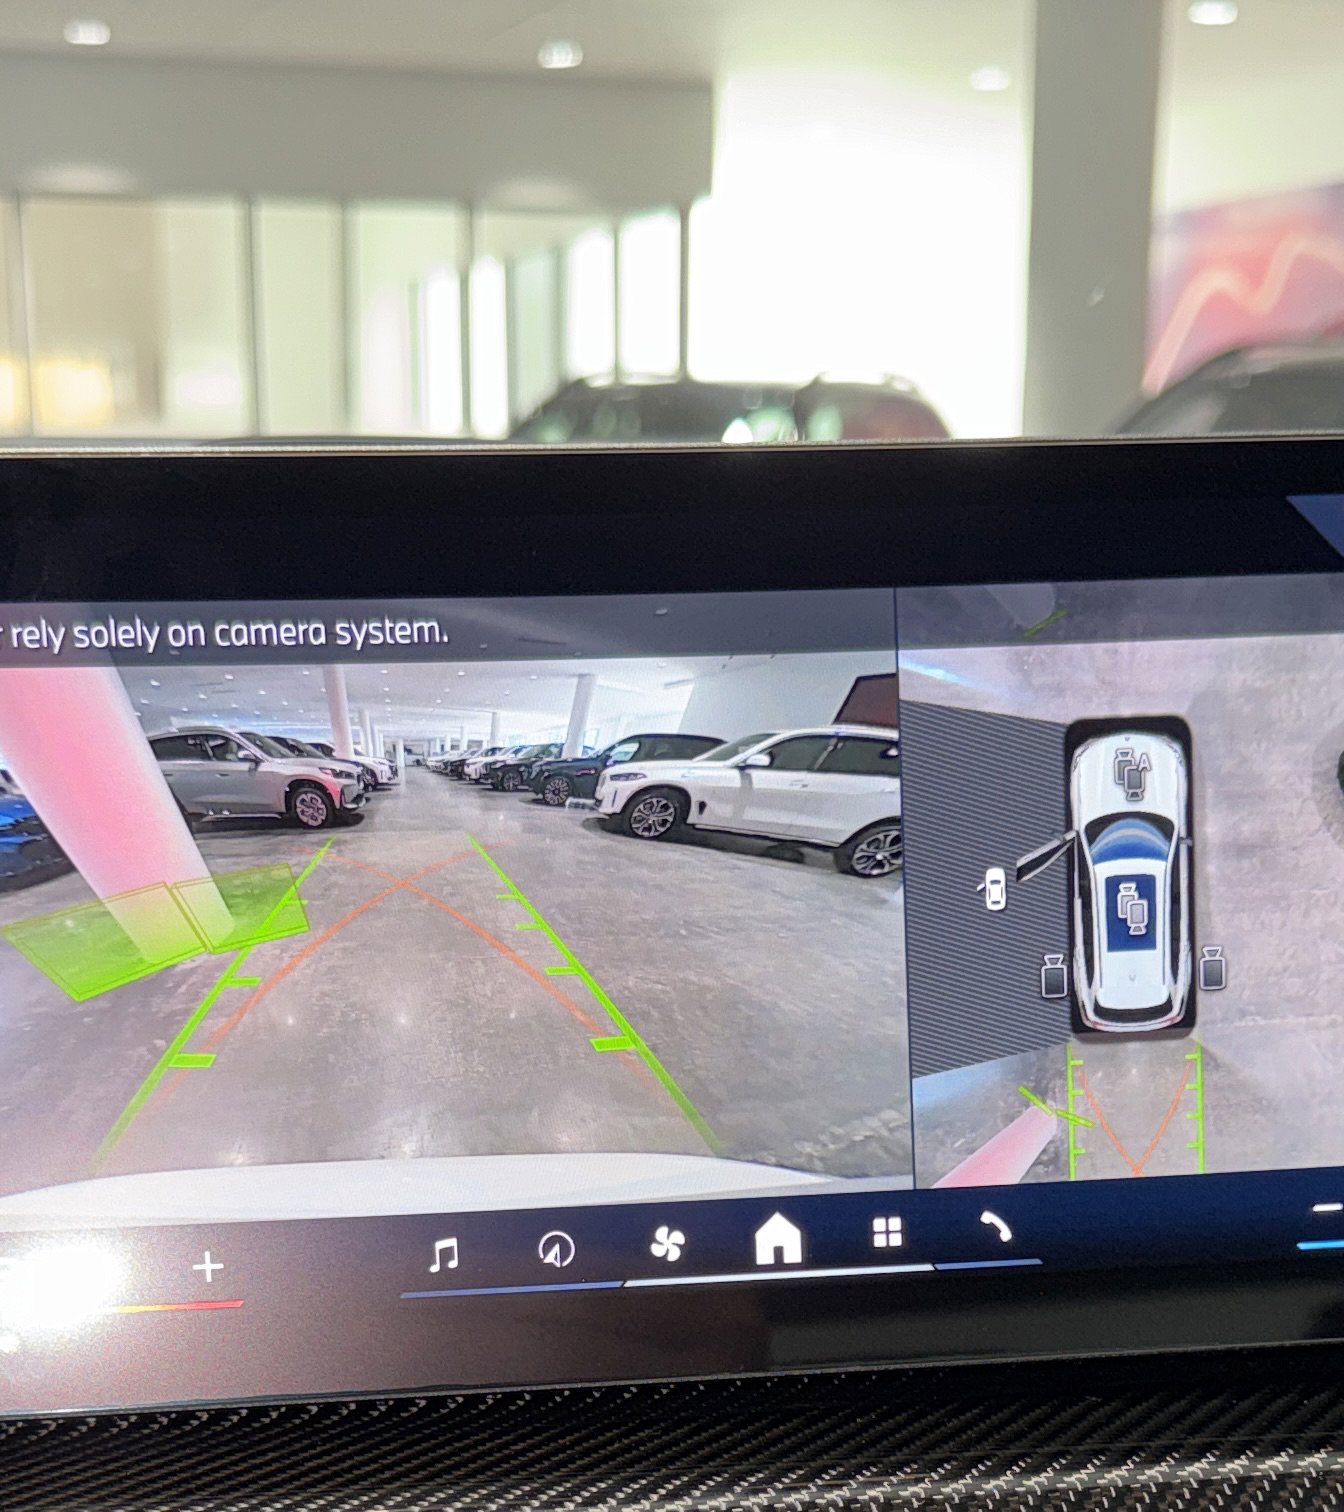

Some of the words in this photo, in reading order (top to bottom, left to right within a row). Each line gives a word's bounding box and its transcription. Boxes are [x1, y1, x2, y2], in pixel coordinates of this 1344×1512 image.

[10, 616, 65, 654] rely
[72, 616, 159, 654] solely
[167, 621, 206, 648] on
[214, 619, 326, 647] camera
[335, 617, 449, 651] system.
